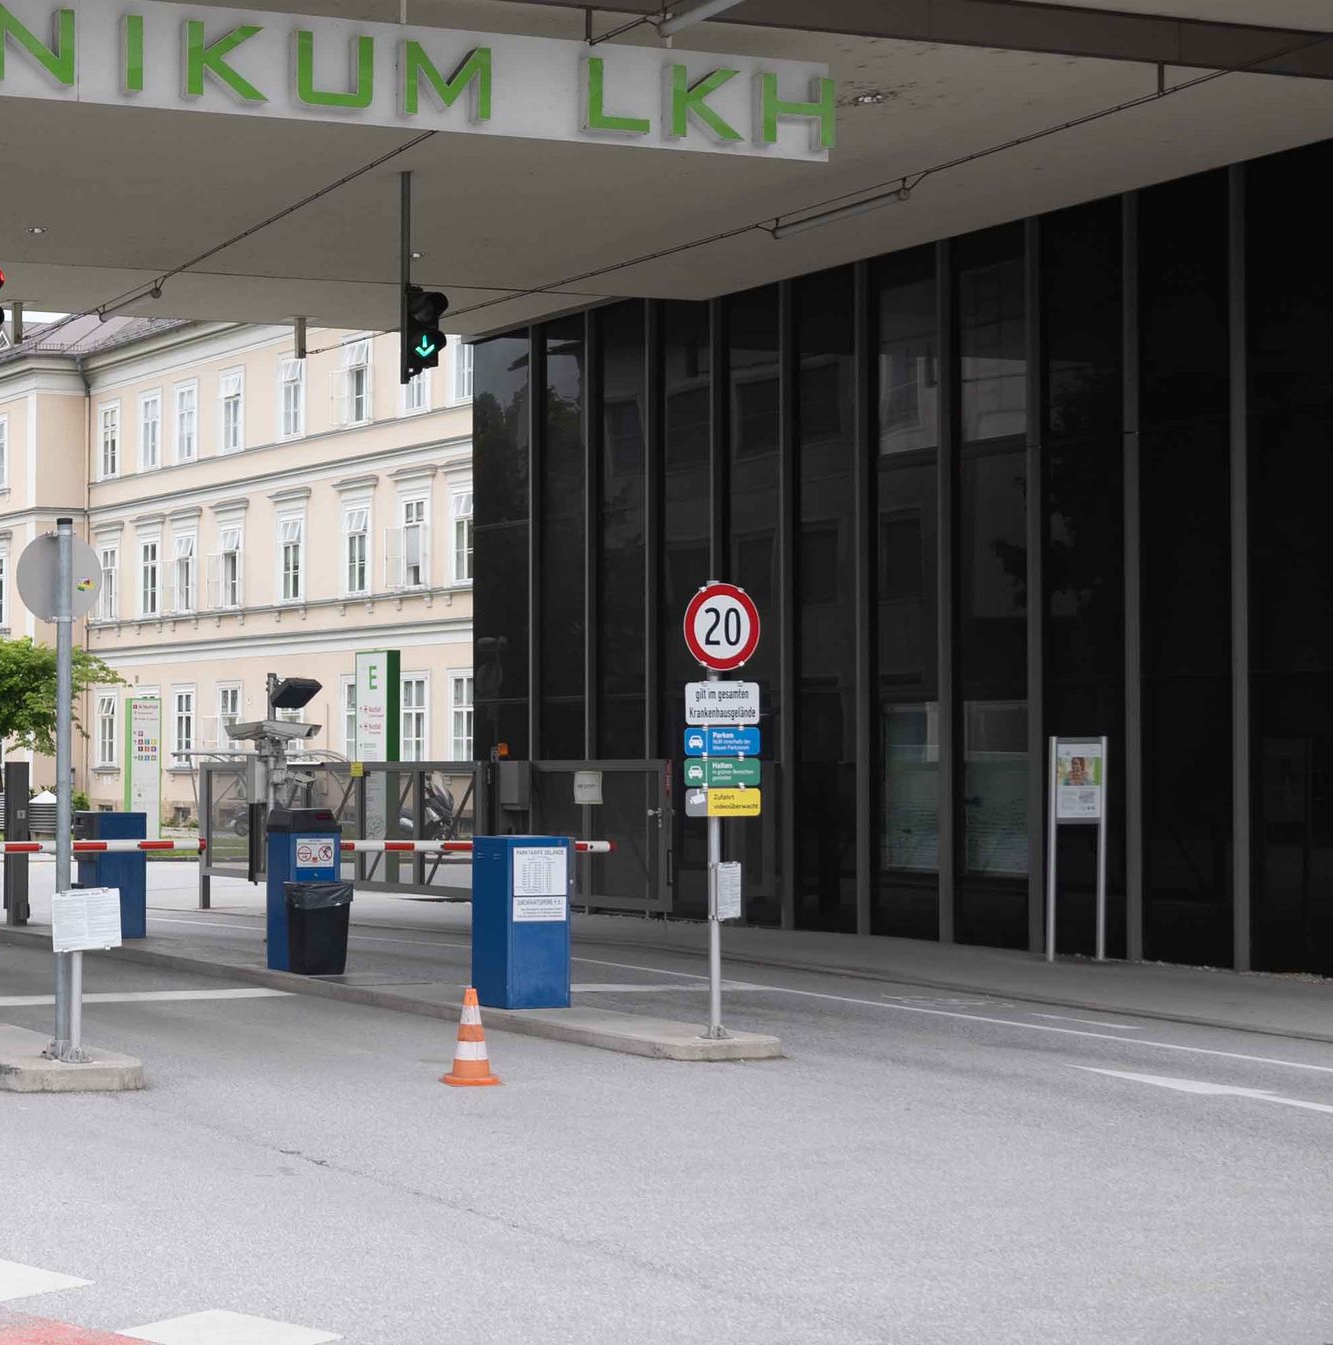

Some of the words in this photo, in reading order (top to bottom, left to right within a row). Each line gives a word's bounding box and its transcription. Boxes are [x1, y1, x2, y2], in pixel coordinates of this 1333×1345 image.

[579, 56, 837, 150] LKH
[704, 607, 741, 646] 20
[368, 665, 378, 690] E
[695, 688, 706, 702] gilt
[708, 688, 716, 699] im
[718, 688, 749, 702] gesamten
[689, 706, 756, 720] Krankenhausgelände
[712, 731, 734, 739] Parken
